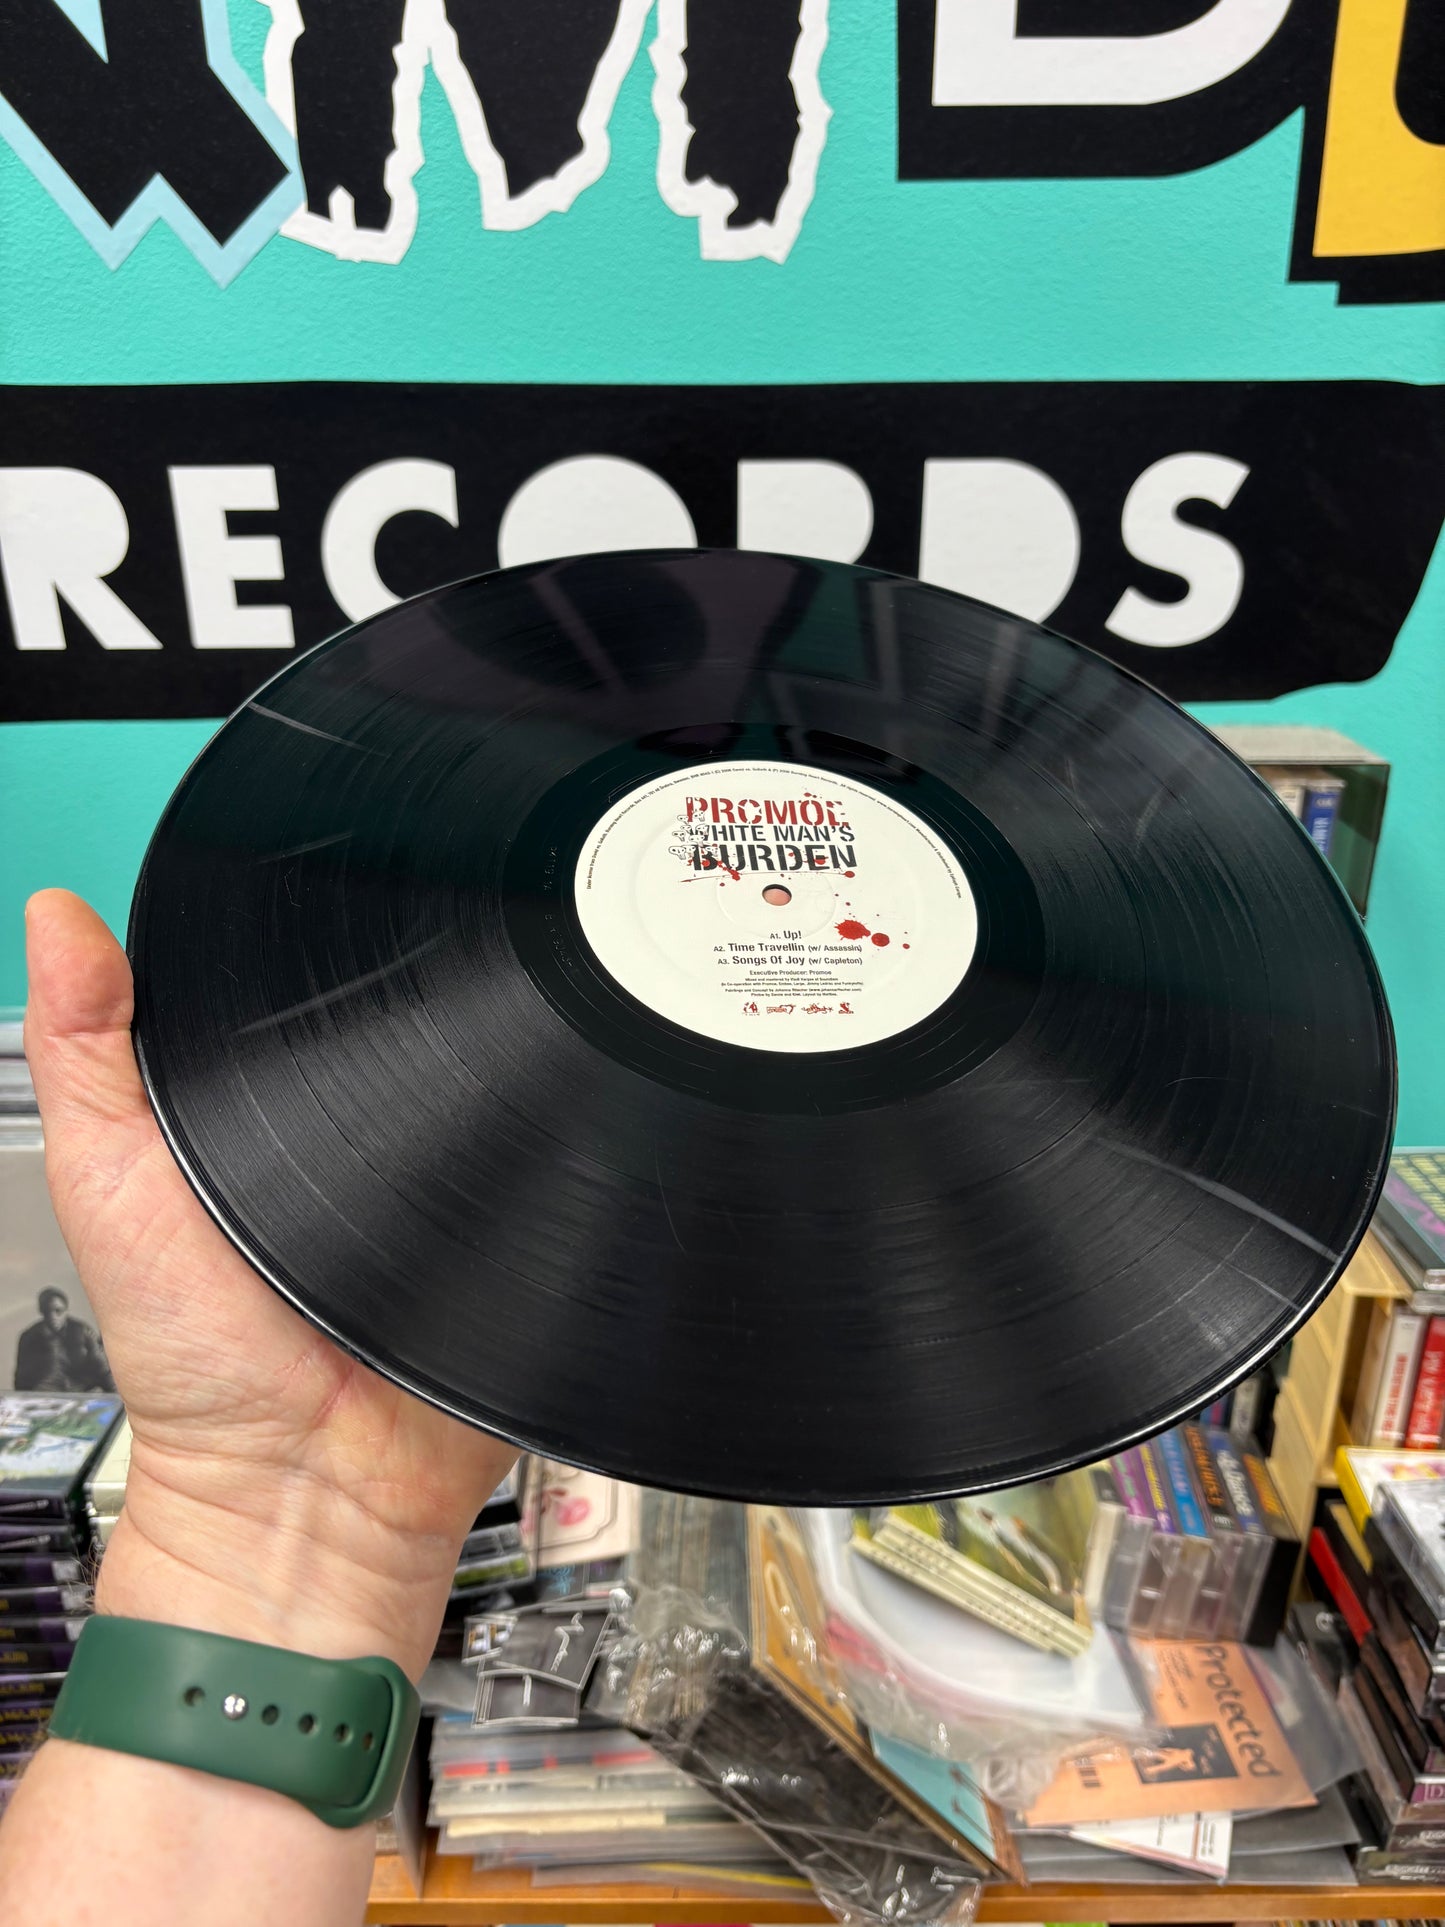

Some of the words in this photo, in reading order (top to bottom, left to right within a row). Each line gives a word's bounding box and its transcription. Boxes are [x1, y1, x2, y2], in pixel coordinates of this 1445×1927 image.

[685, 796, 849, 827] PROMOE
[773, 824, 856, 842] MAN'S
[690, 843, 858, 871] BURDEN
[783, 930, 802, 940] Up!
[727, 942, 755, 952] Time
[757, 942, 805, 952] Travellin
[807, 944, 821, 953] (w/
[823, 944, 862, 952] Assassin)
[732, 955, 768, 966] Songs
[769, 955, 782, 964] Of
[785, 955, 805, 966] Joy
[808, 957, 821, 965] (w/
[824, 957, 862, 965] Capleton)
[1196, 1644, 1283, 1777] Protected
